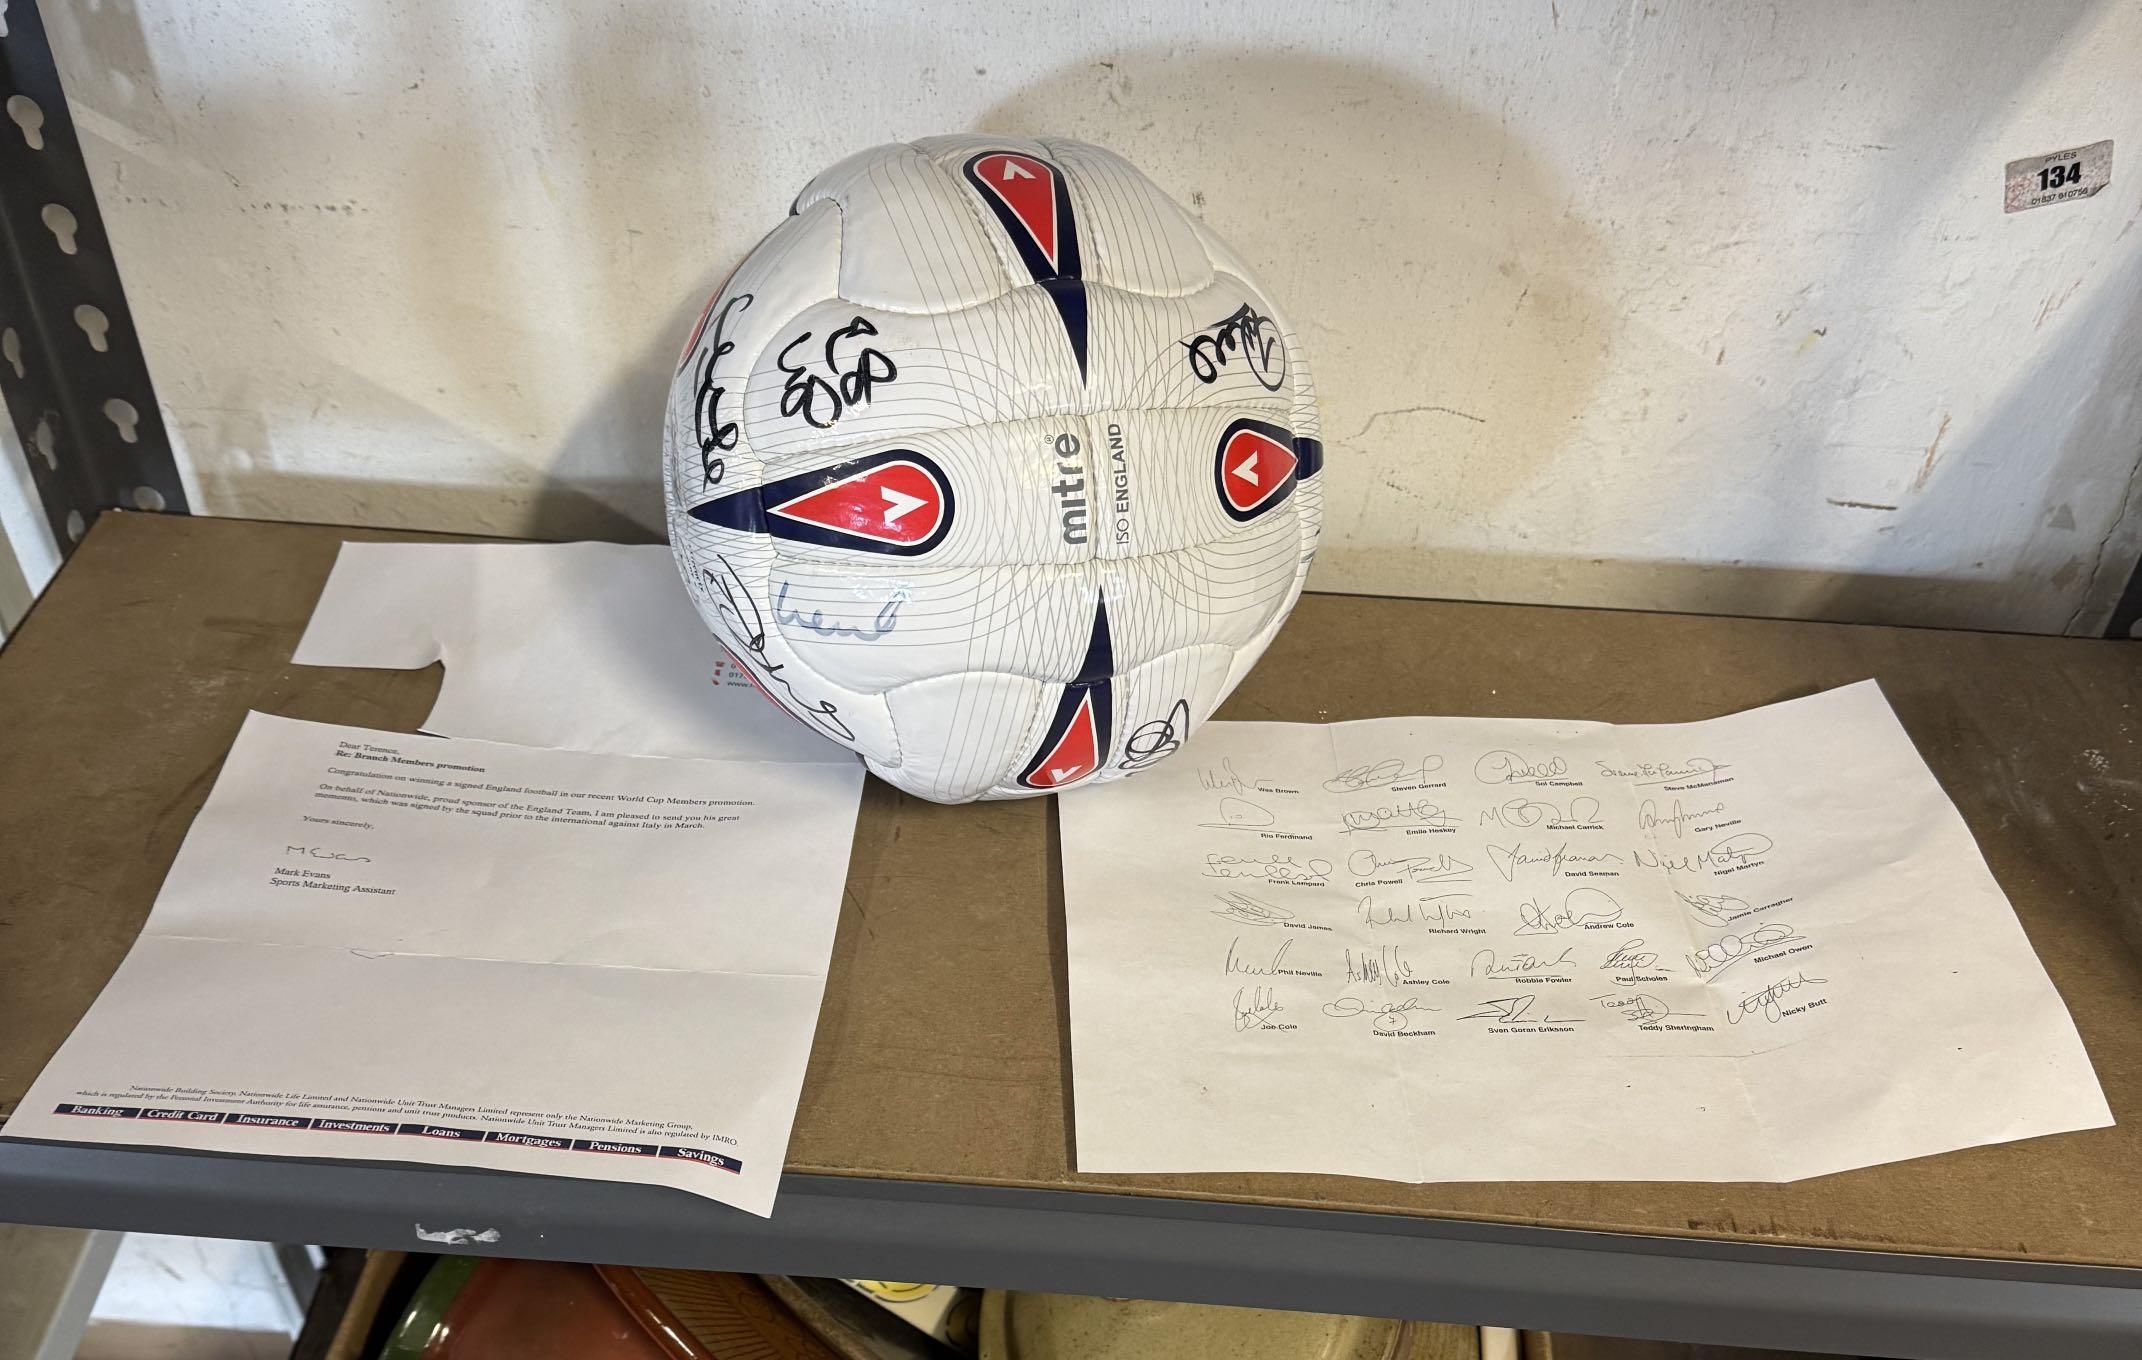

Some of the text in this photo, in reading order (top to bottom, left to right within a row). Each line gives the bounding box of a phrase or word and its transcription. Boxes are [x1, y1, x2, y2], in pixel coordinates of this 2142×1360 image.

[2037, 162, 2081, 191] 134
[1052, 433, 1087, 544] mitre
[1108, 424, 1129, 544] ISO ENGLAND
[338, 741, 360, 749] Dear
[353, 752, 388, 761] Branch
[390, 756, 433, 766] Members
[435, 763, 484, 772] promotion
[409, 777, 444, 786] winning
[485, 784, 522, 792] England
[524, 787, 558, 796] football
[646, 796, 664, 804] Cup
[455, 805, 470, 813] the
[551, 817, 606, 825] international
[526, 804, 562, 813] England
[566, 808, 591, 816] Team,
[1714, 819, 1741, 828] Neville
[274, 867, 330, 878] Mark Evans
[1735, 861, 1764, 870] Martyn
[269, 877, 396, 894] Sports Marketing Assistant
[1727, 897, 1793, 921] Jamie Carragher
[1753, 944, 1813, 963] Michael Owen
[1781, 998, 1826, 1016] Nicky Butt
[438, 1103, 474, 1112] Managers
[580, 1115, 623, 1123] Nationwide
[625, 1119, 664, 1128] Marketing
[480, 1115, 525, 1123] Nationwide
[568, 1122, 605, 1131] Managers
[607, 1125, 637, 1133] Limited
[72, 1106, 724, 1166] Banking Credit Card Insurance Investments Loans Mortgages Pensions Savings
